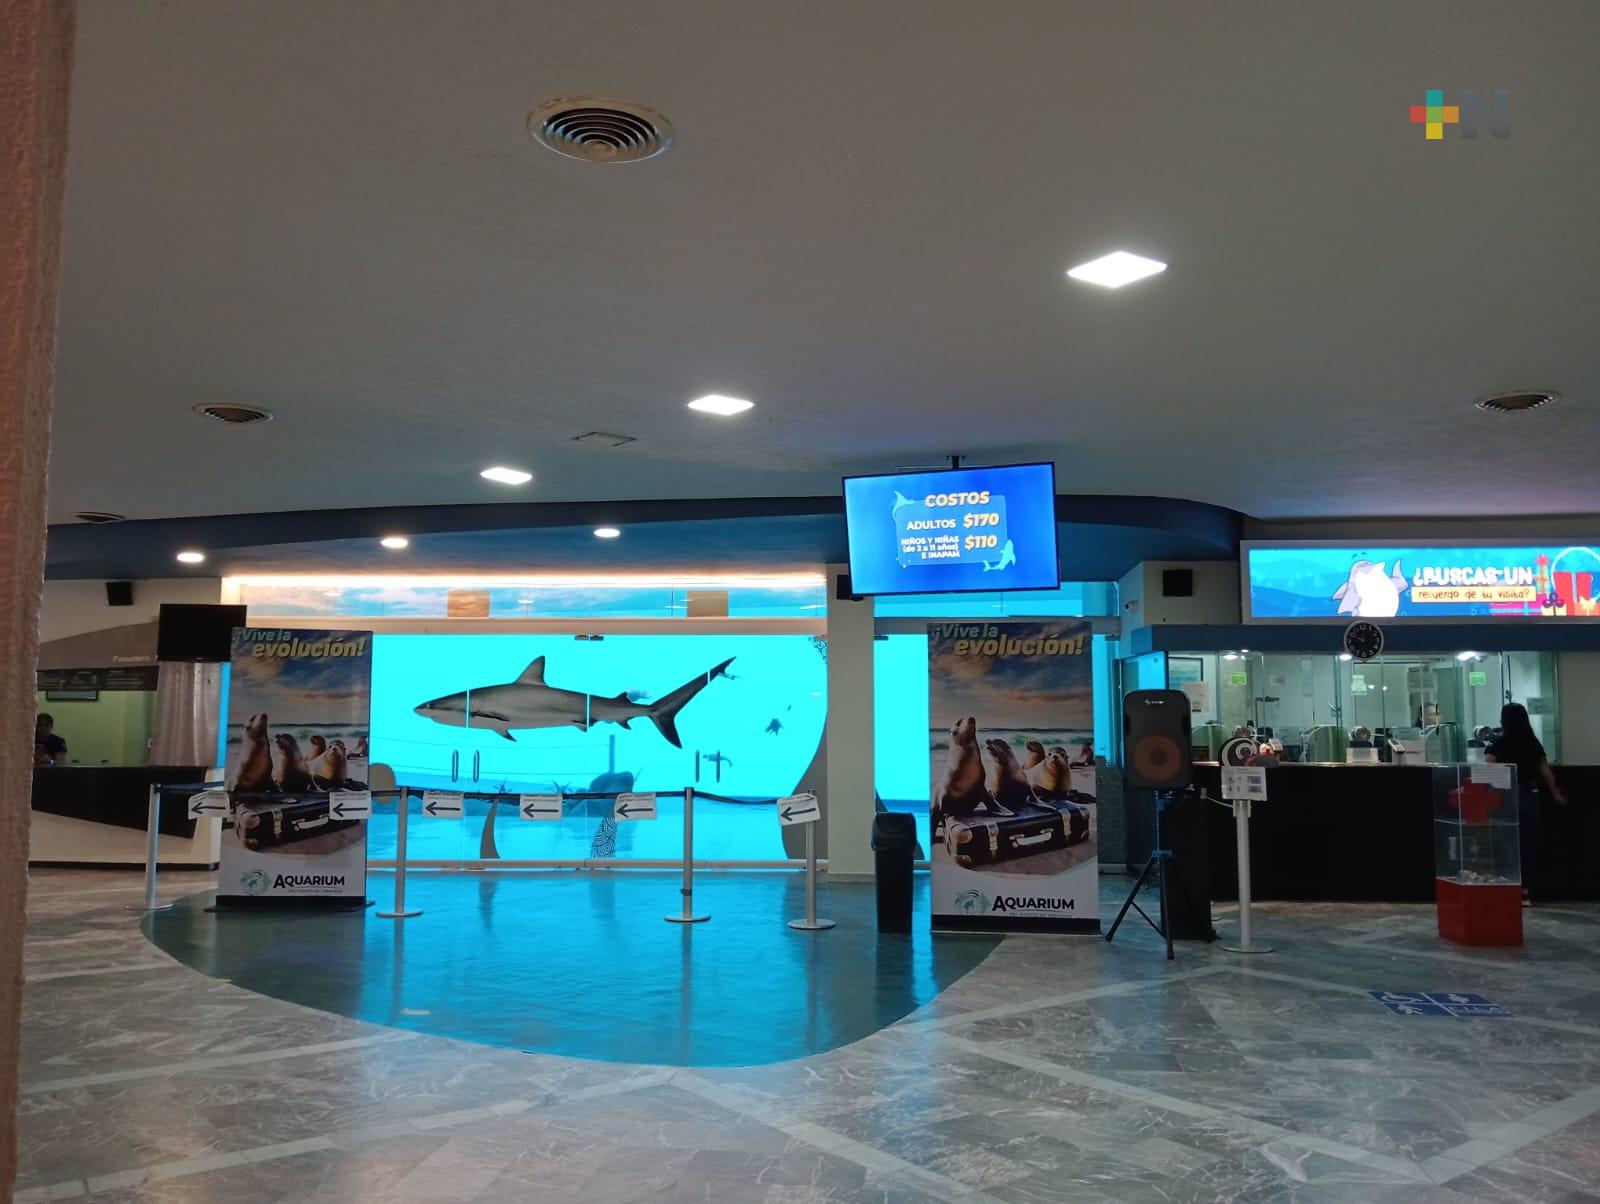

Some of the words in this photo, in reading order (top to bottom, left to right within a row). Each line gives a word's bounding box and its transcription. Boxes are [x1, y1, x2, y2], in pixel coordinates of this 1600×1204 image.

[925, 491, 990, 507] COSTOS
[907, 518, 957, 531] ADULTOS
[963, 512, 1000, 529] $170
[901, 536, 927, 546] NIÑOS
[934, 534, 960, 544] NIÑAS
[903, 545, 915, 553] (de
[937, 543, 959, 552] años)
[965, 534, 998, 550] $110
[1413, 566, 1498, 586] ¿BUSCAS
[1503, 566, 1533, 585] UN
[1418, 589, 1459, 599] recuerdo
[1465, 590, 1477, 599] de
[1482, 590, 1492, 599] tu
[1498, 588, 1530, 599] visita?
[278, 629, 291, 641] la
[935, 622, 979, 641] ¡Vive
[982, 622, 998, 638] la
[252, 637, 366, 658] evolución!
[954, 633, 1085, 656] evolución!
[273, 874, 345, 889] AQUARIUM
[992, 895, 1075, 912] AQUARIUM
